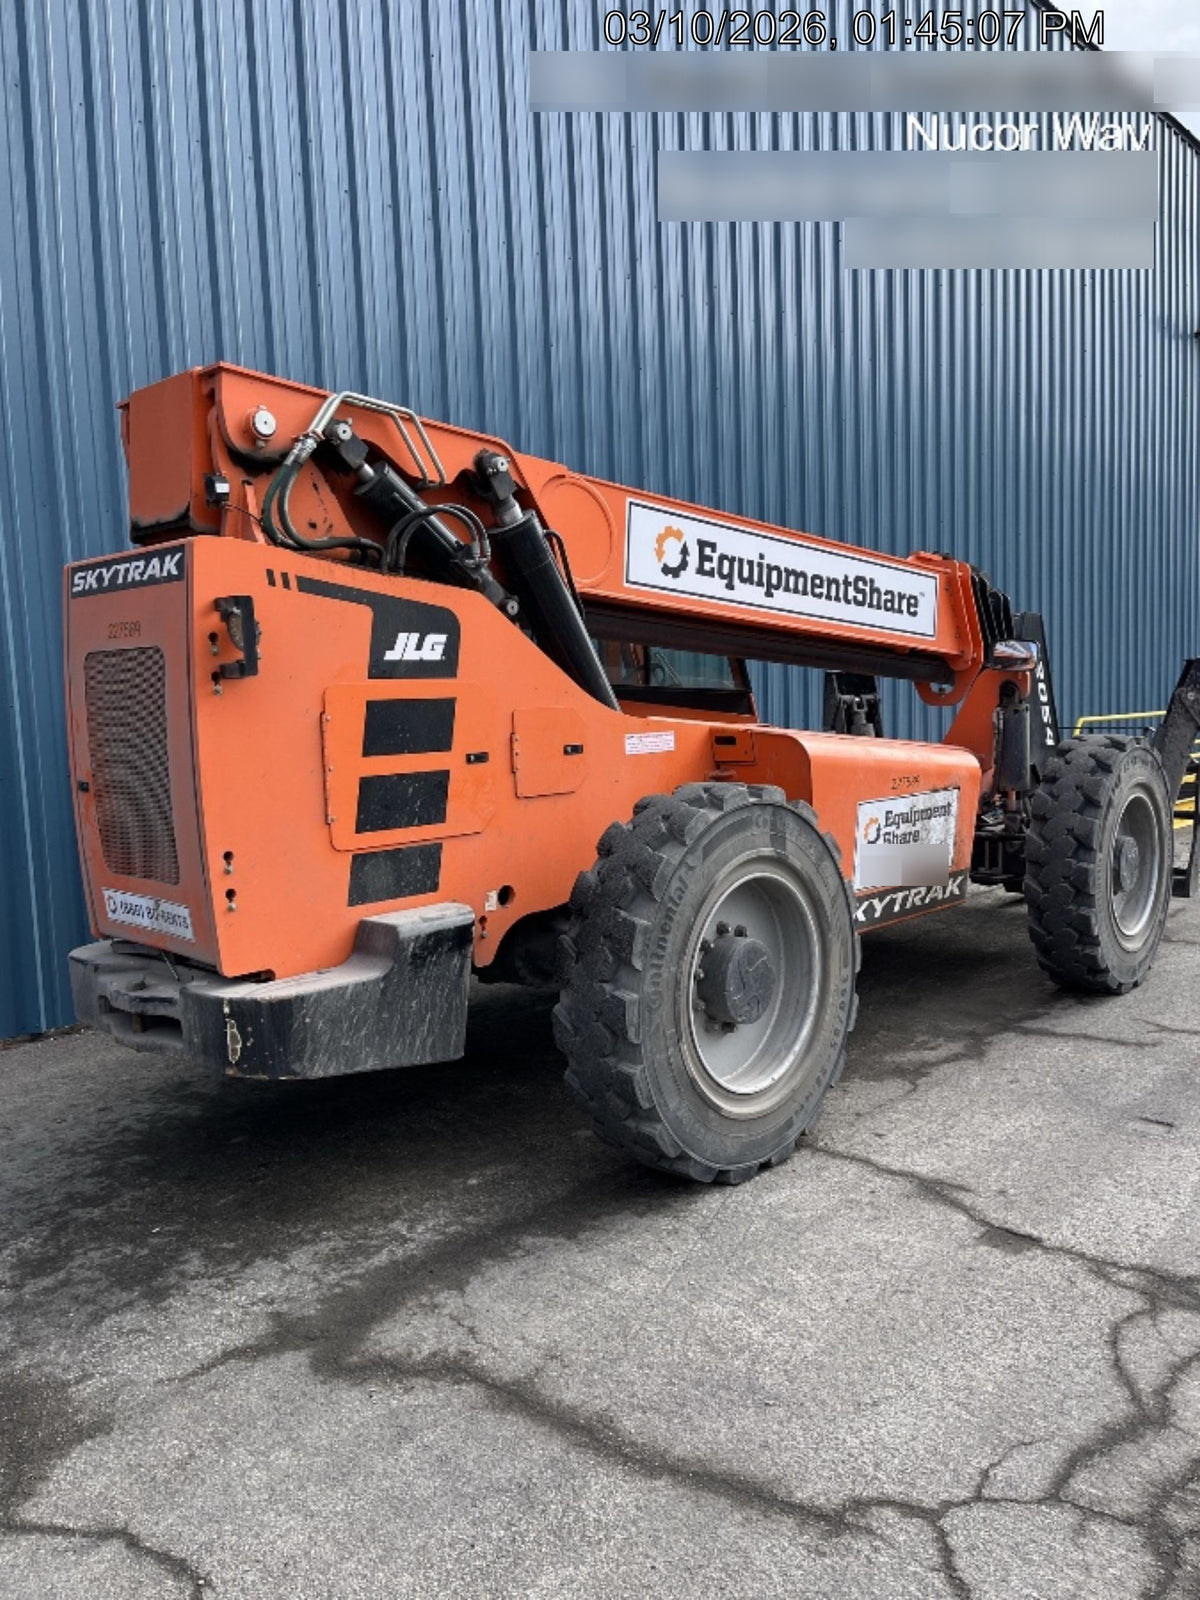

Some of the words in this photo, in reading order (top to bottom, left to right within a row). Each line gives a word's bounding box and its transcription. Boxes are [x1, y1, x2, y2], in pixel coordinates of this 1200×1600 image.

[72, 552, 183, 593] SKYTRAK
[695, 538, 919, 617] EquipmentShare
[383, 632, 448, 661] JLG
[883, 801, 952, 829] Equipment
[882, 829, 920, 845] Share
[853, 876, 964, 922] KYTRAK
